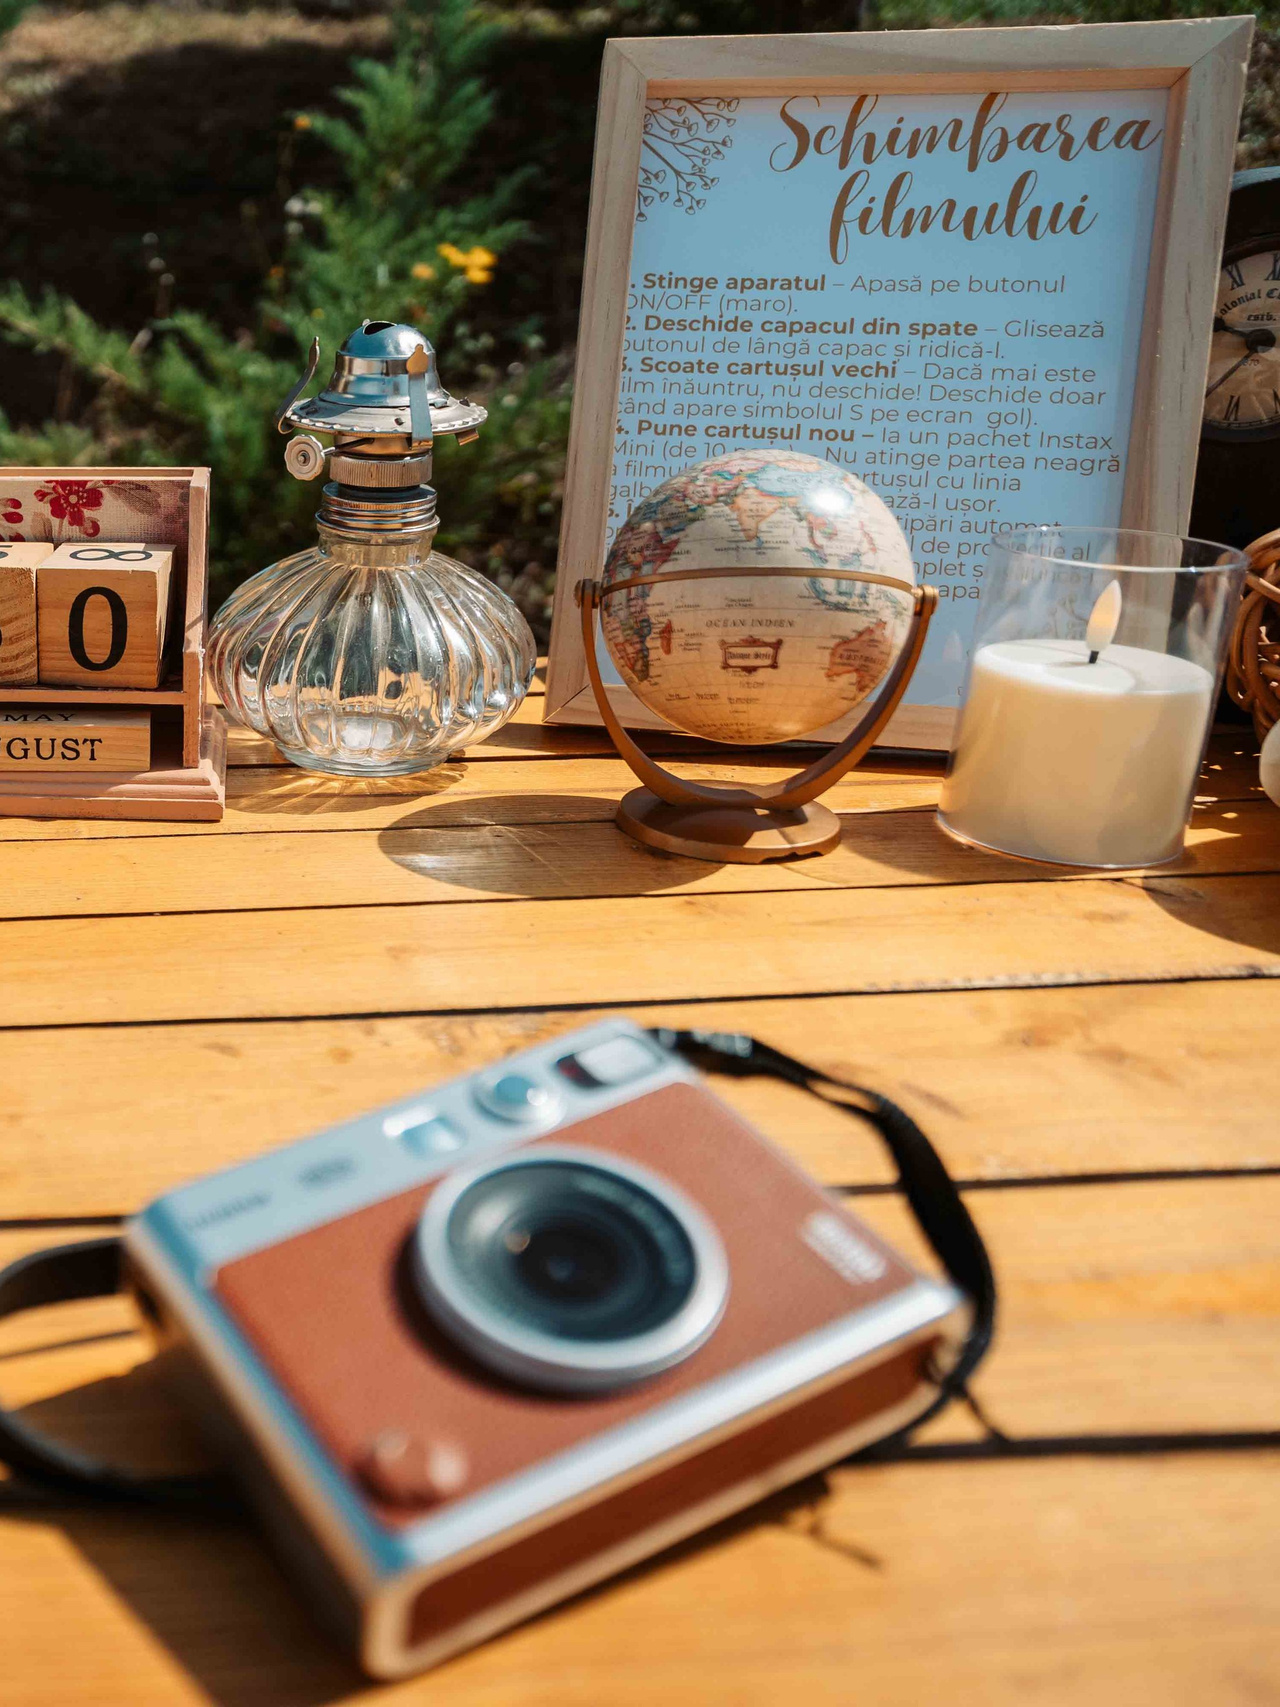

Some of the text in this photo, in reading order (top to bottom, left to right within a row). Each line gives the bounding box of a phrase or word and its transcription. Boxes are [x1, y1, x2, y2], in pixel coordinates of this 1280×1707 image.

[769, 91, 1163, 173] Schimbarea
[829, 169, 1099, 265] filmului
[643, 272, 718, 294] Stinge
[725, 274, 826, 294] aparatul
[850, 275, 922, 295] Apasă
[930, 278, 960, 296] pe
[968, 275, 1066, 294] butonul
[719, 294, 798, 316] (maro).
[644, 315, 754, 332] Deschide
[760, 318, 855, 336] capacul
[862, 317, 901, 335] din
[908, 320, 978, 339] spate
[1004, 319, 1106, 338] Glisează
[712, 336, 741, 353] de
[748, 338, 811, 358] lângă
[818, 341, 887, 360] capac
[894, 340, 911, 362] și
[919, 341, 1005, 359] ridică-l.
[640, 356, 720, 374] Scoate
[727, 360, 825, 382] cartușul
[832, 360, 897, 378] vechi
[923, 363, 983, 381] Dacă
[991, 364, 1037, 382] mai
[1044, 366, 1096, 383] este
[621, 376, 1107, 405] ilm înăuntru, nu deschide! Deschide doar
[673, 402, 737, 419] apare
[743, 402, 842, 420] simbolul
[850, 404, 864, 421] S
[871, 406, 900, 424] pe
[906, 409, 973, 424] ecran
[987, 407, 1038, 430] gol).
[637, 420, 697, 437] Pune
[704, 422, 801, 445] cartușul
[809, 428, 855, 442] nou
[909, 430, 939, 445] un
[947, 429, 1032, 449] pachet
[1039, 431, 1113, 450] Instax
[614, 439, 655, 457] Mini
[662, 440, 697, 461] (de
[704, 442, 726, 458] 10
[825, 446, 857, 464] Nu
[865, 448, 941, 470] atinge
[948, 453, 1026, 471] partea
[1034, 455, 1120, 476] neagră
[850, 470, 929, 491] rtușul
[937, 474, 964, 489] cu
[972, 472, 1021, 491] linia
[883, 492, 937, 510] ază-l
[945, 497, 1001, 517] ușor.
[921, 536, 951, 554] de
[3, 713, 75, 722] MAY
